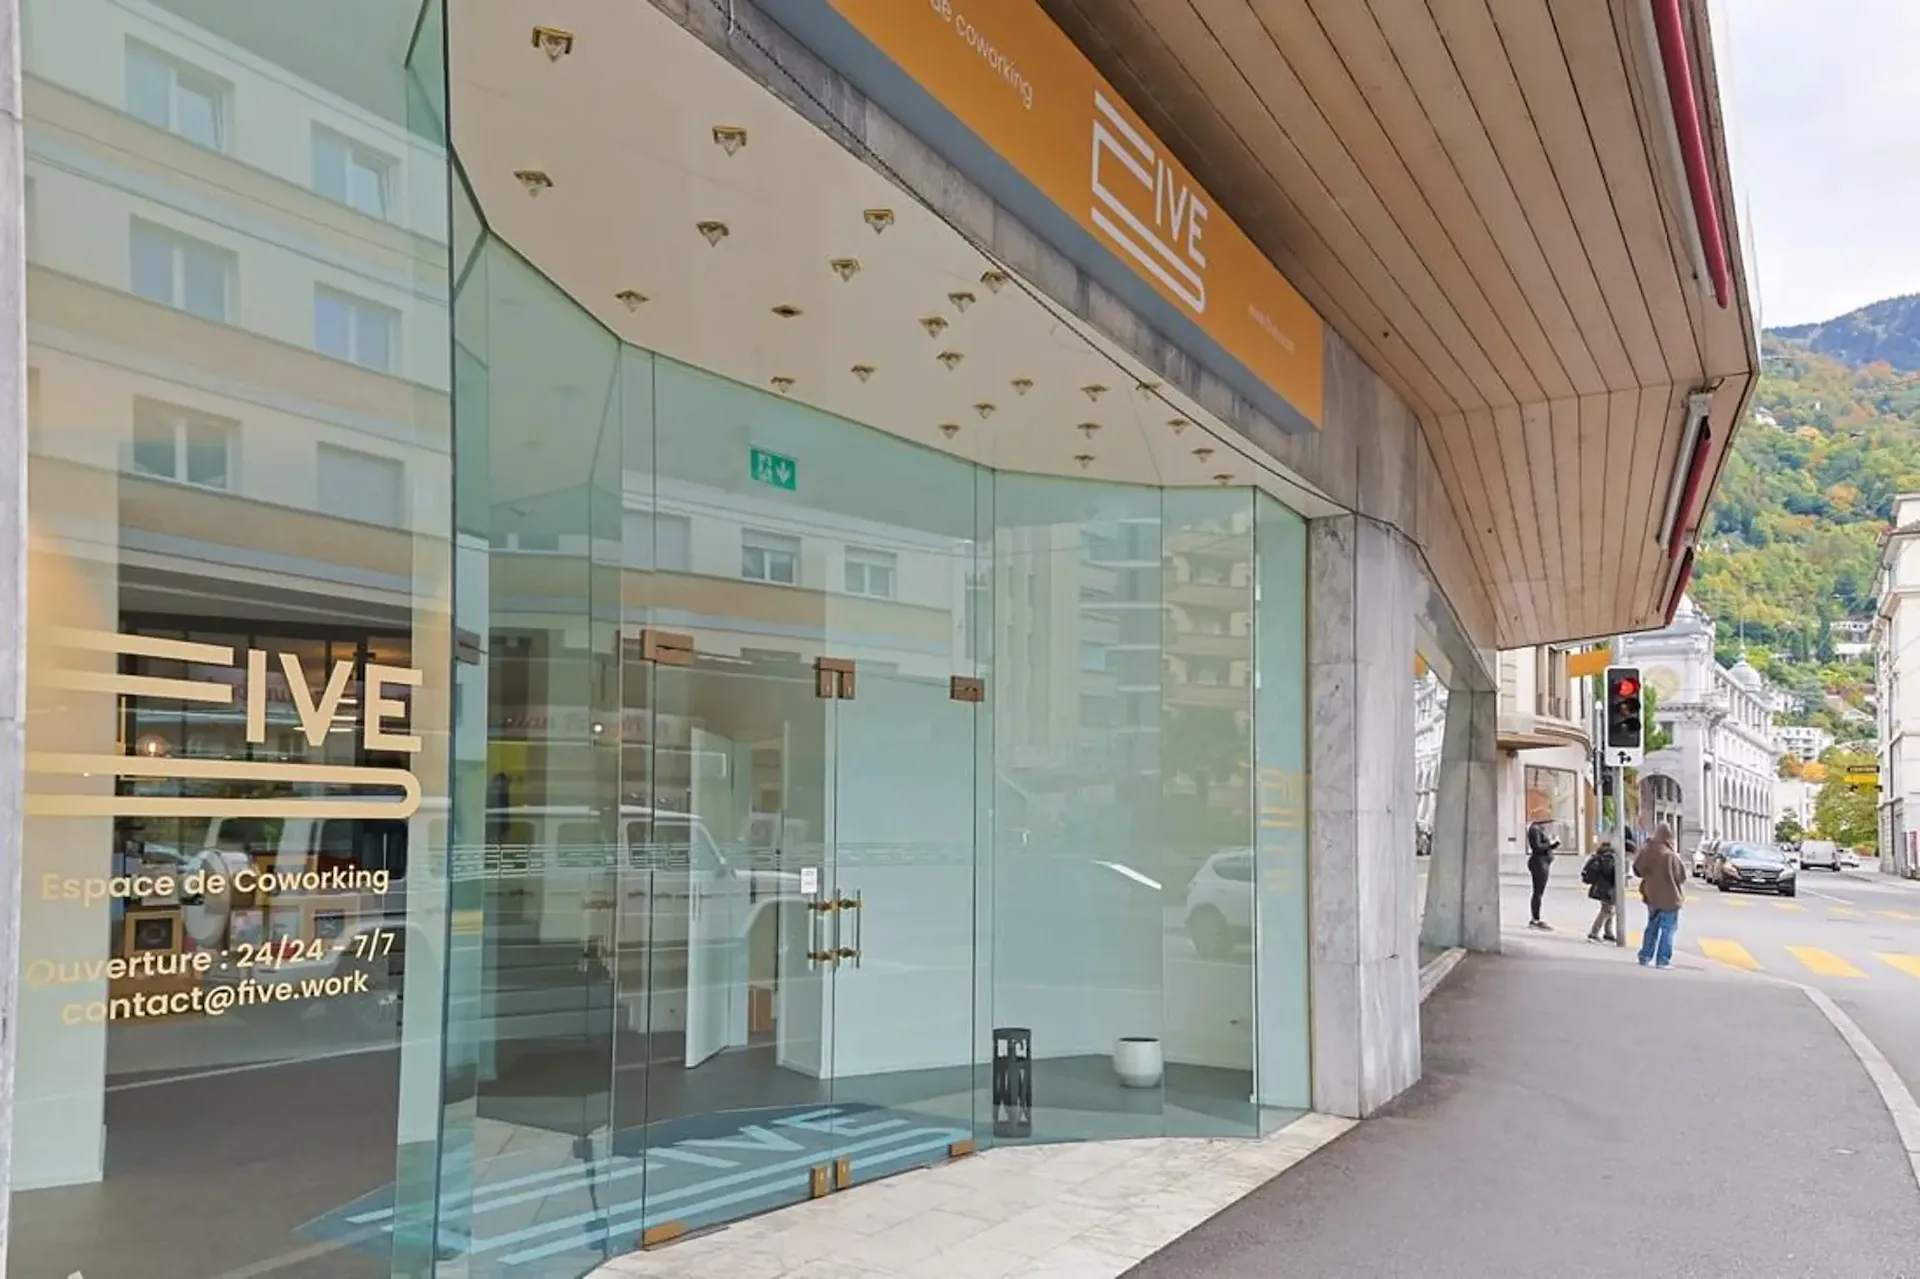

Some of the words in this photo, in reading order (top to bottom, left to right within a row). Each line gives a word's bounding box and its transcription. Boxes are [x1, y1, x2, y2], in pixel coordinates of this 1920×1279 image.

[956, 14, 1032, 109] coworking
[42, 873, 175, 907] Espace
[184, 869, 225, 895] de
[235, 865, 389, 894] Coworking
[27, 951, 212, 987] Ouverture
[237, 934, 324, 970] 24/24
[353, 928, 395, 962] 7/7
[62, 970, 369, 1025] contact@five.work
